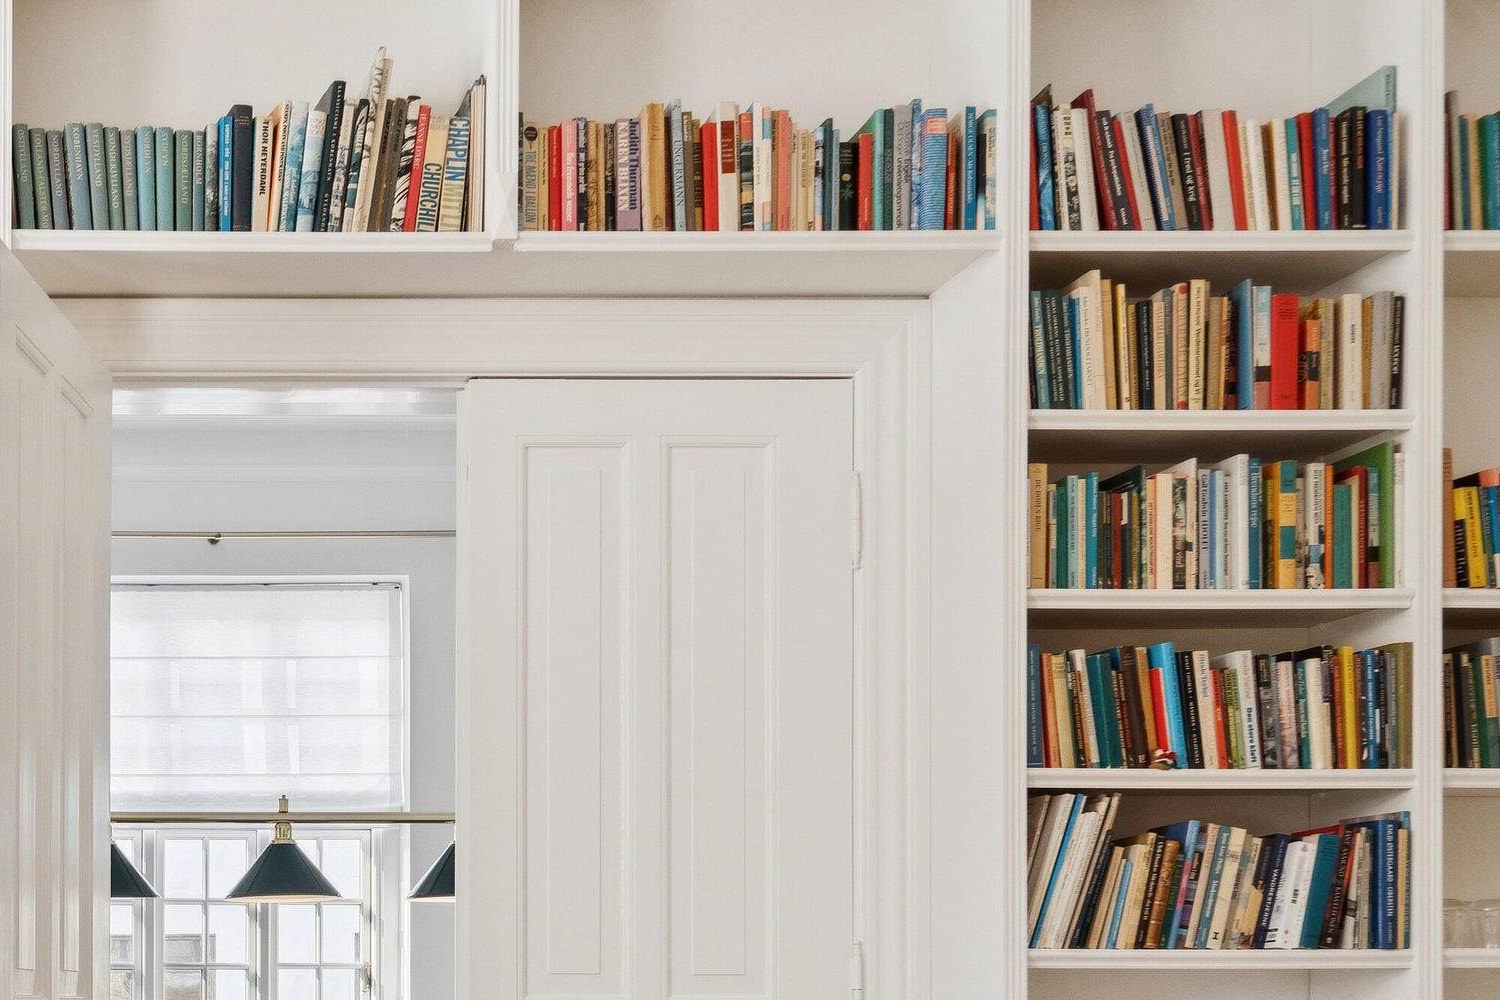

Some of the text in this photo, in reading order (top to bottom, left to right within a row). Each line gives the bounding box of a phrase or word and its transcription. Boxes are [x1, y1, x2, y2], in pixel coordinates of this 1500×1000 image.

[333, 85, 343, 131] KLASSICISME
[416, 113, 426, 143] JEANNE
[18, 129, 28, 182] ØSTJYLLAND
[52, 134, 63, 196] NORDJYLLAND
[72, 127, 83, 180] KØBENHAVN
[91, 129, 102, 186] VESTJYLLAND
[109, 133, 119, 208] SØNDERJYLLAND
[124, 134, 134, 196] SYDSJÆLLAND
[144, 131, 152, 173] NORDFYN
[161, 132, 169, 166] SYDFYN
[180, 134, 189, 204] NORDSJÆLLAND
[195, 135, 203, 185] BORNHOLM
[259, 120, 270, 196] THOR HEYERDAHL
[326, 139, 336, 181] KØBENHAVN
[445, 118, 470, 181] CHAPLIN
[526, 150, 535, 164] TRE
[618, 121, 629, 211] KAREN BLIXEN
[629, 119, 639, 210] Judith Thurman
[674, 140, 684, 207] UNGERMANN
[1183, 158, 1192, 173] fred
[33, 133, 48, 230] LOLLAND-FALSTER-MØ
[526, 166, 536, 188] MÆND
[1182, 175, 1193, 184] og
[1186, 186, 1196, 201] krig
[319, 193, 329, 231] GYLDENDA
[526, 196, 535, 223] BALLON
[1193, 379, 1200, 387] og
[1035, 480, 1041, 489] DE
[1250, 473, 1259, 527] Brendans rejse
[1246, 707, 1257, 763] Den store kløft
[1386, 824, 1394, 840] KNUD
[1261, 868, 1279, 927] VANDRESTJERNE
